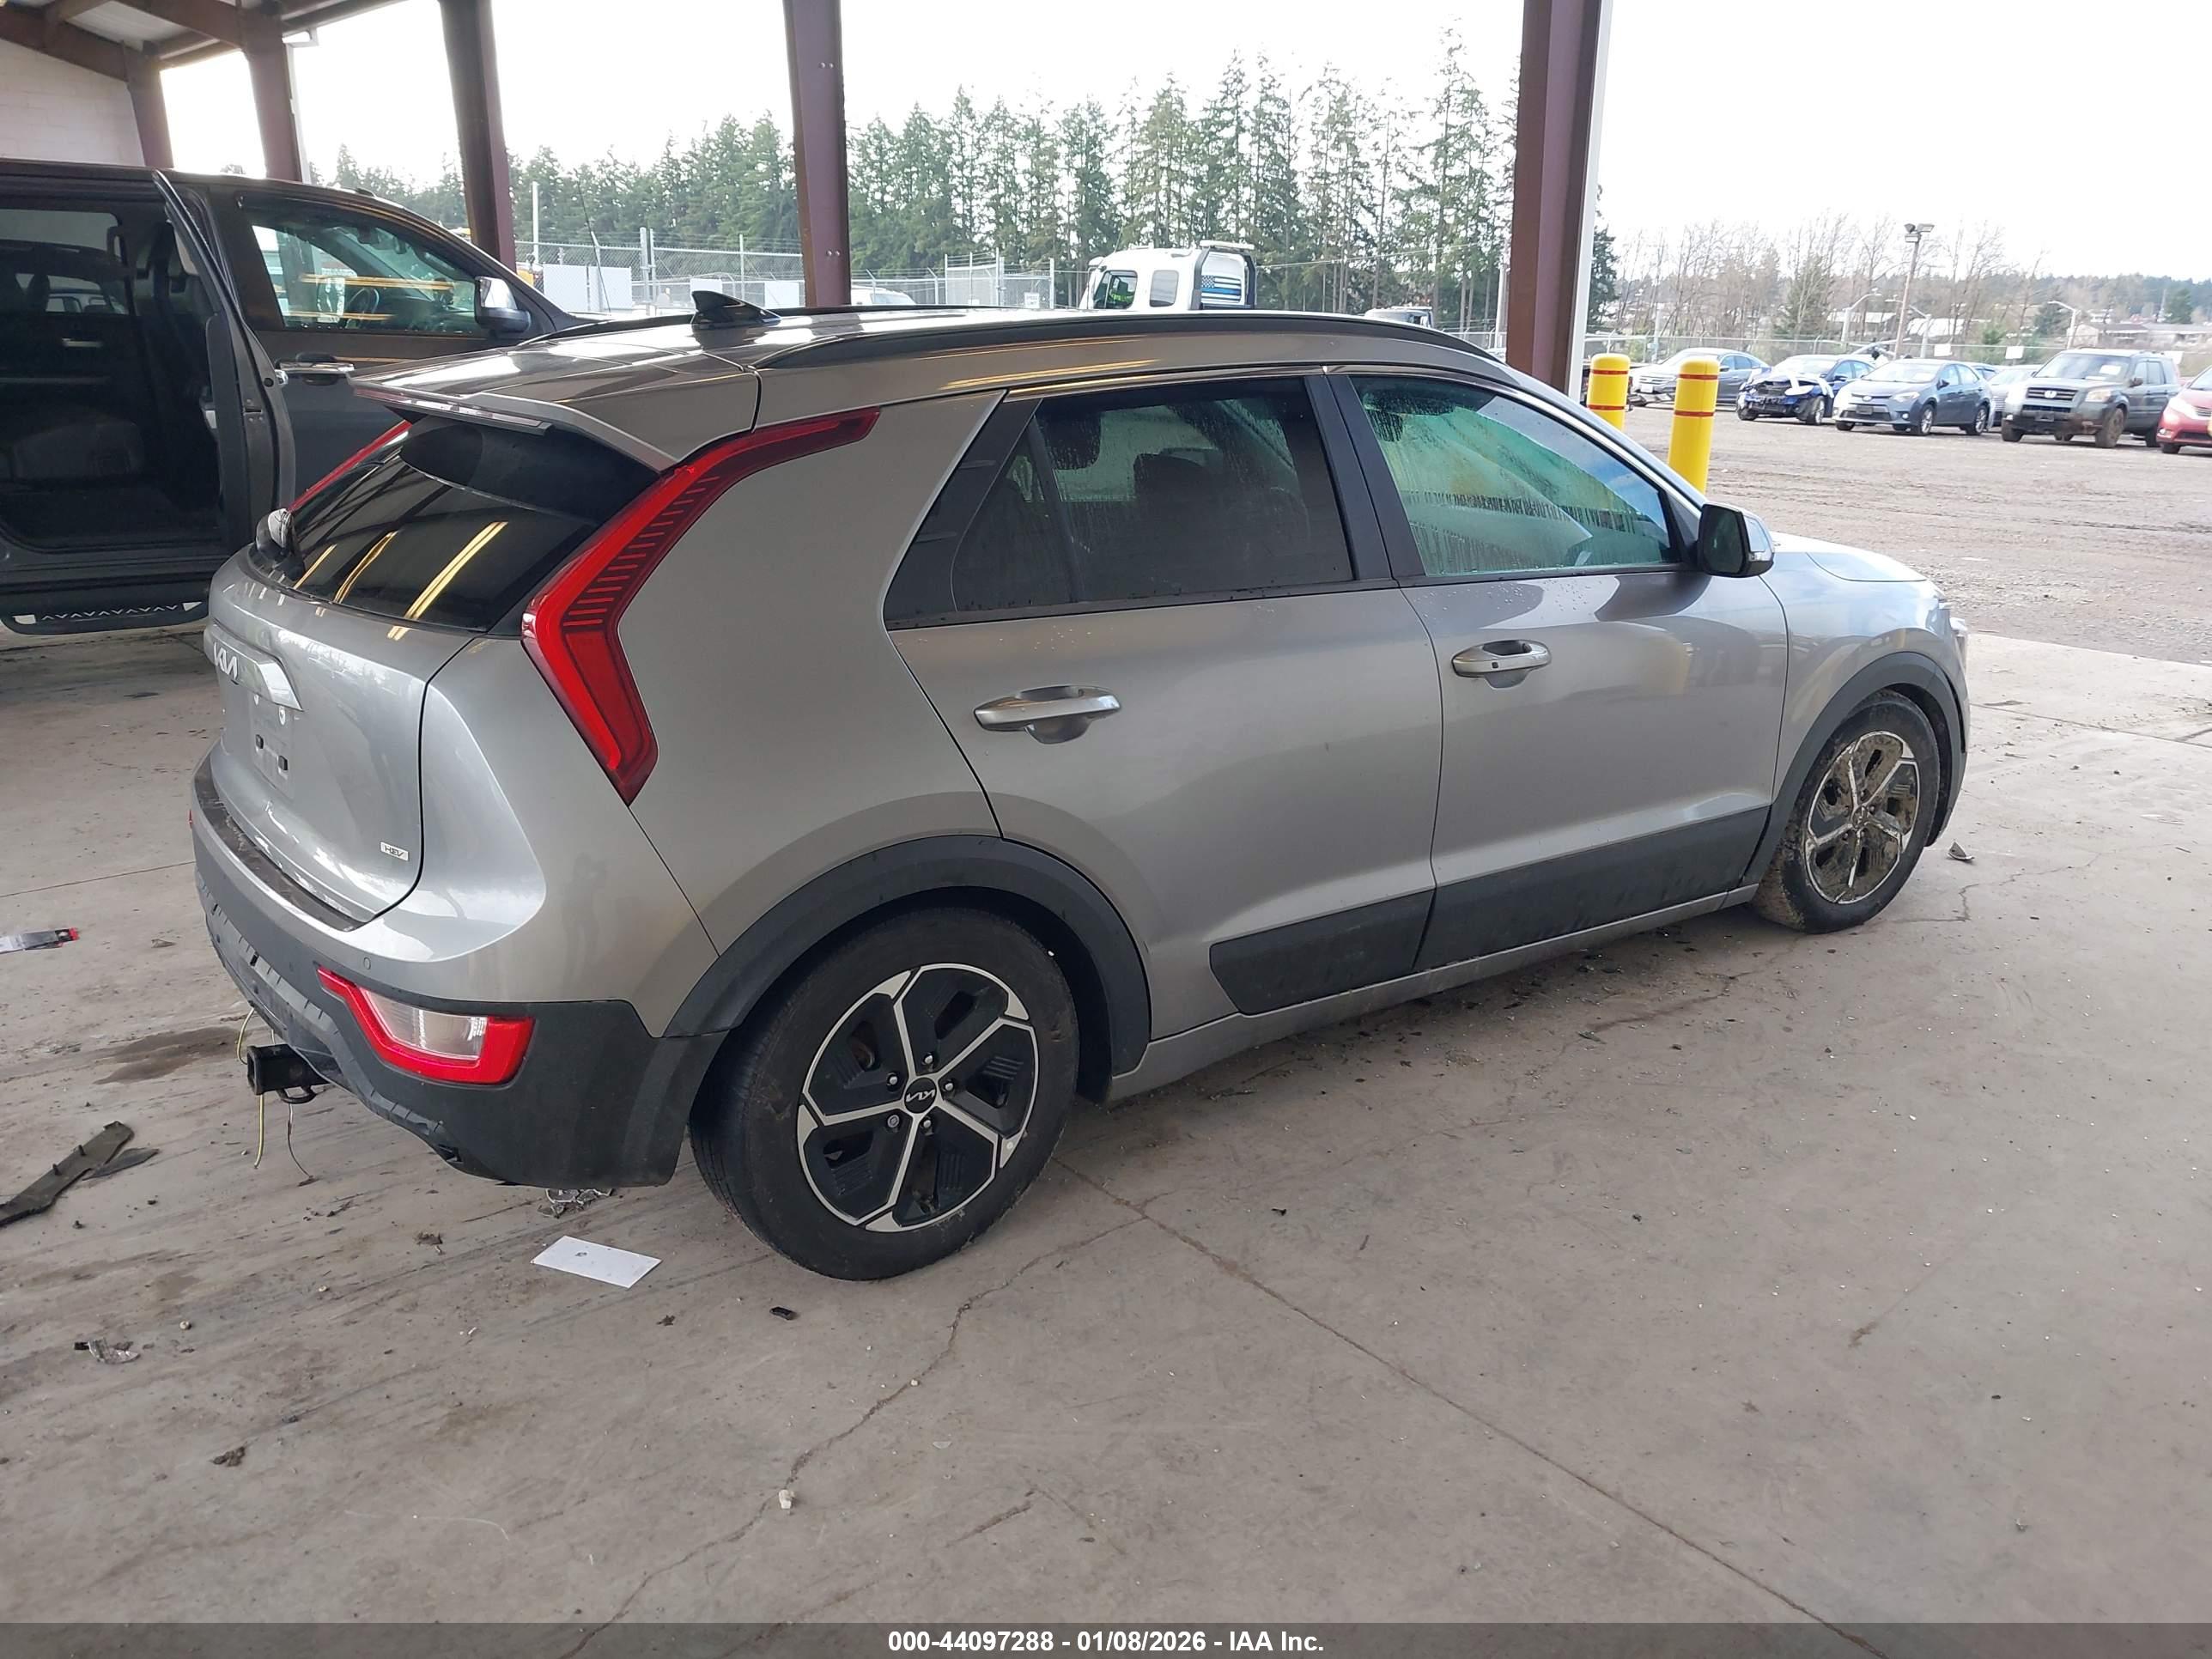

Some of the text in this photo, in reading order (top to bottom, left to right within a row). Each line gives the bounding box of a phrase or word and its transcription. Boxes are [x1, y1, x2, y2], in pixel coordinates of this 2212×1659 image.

[213, 641, 238, 680] KIA
[384, 845, 404, 857] HEV
[906, 1089, 936, 1103] KIA
